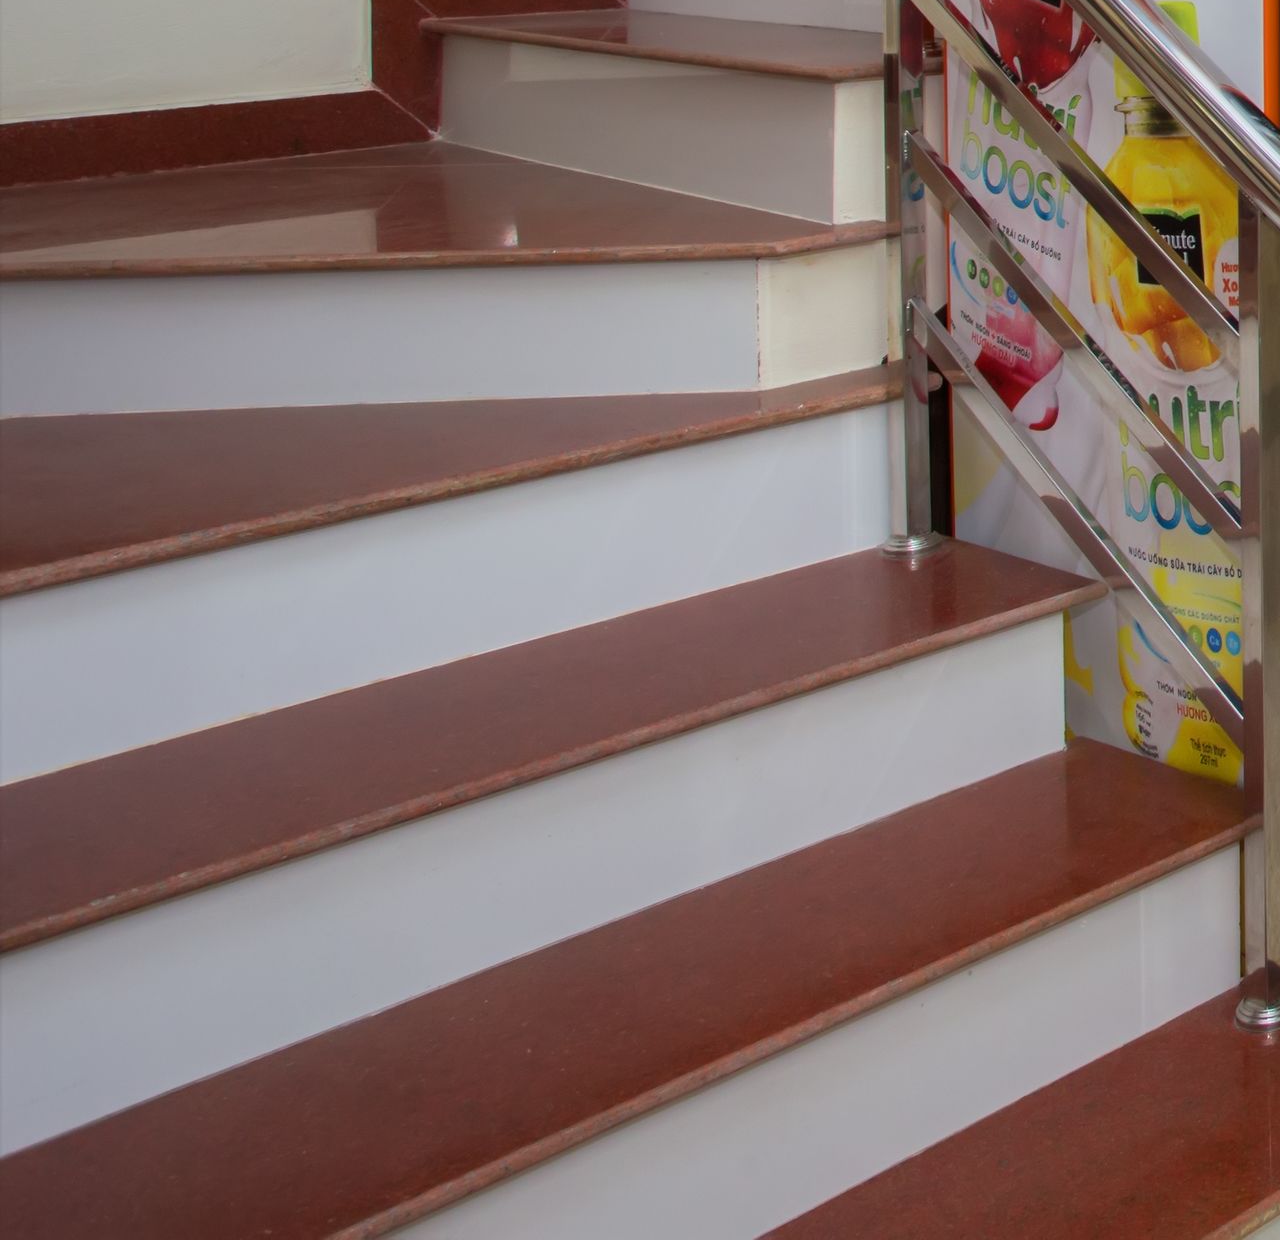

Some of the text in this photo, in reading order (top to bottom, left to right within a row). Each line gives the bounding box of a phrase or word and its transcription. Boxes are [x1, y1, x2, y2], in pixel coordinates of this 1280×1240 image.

[960, 118, 1070, 230] boost
[1152, 225, 1197, 250] nute
[1187, 562, 1206, 576] TRÁI
[1207, 564, 1223, 578] CÂY
